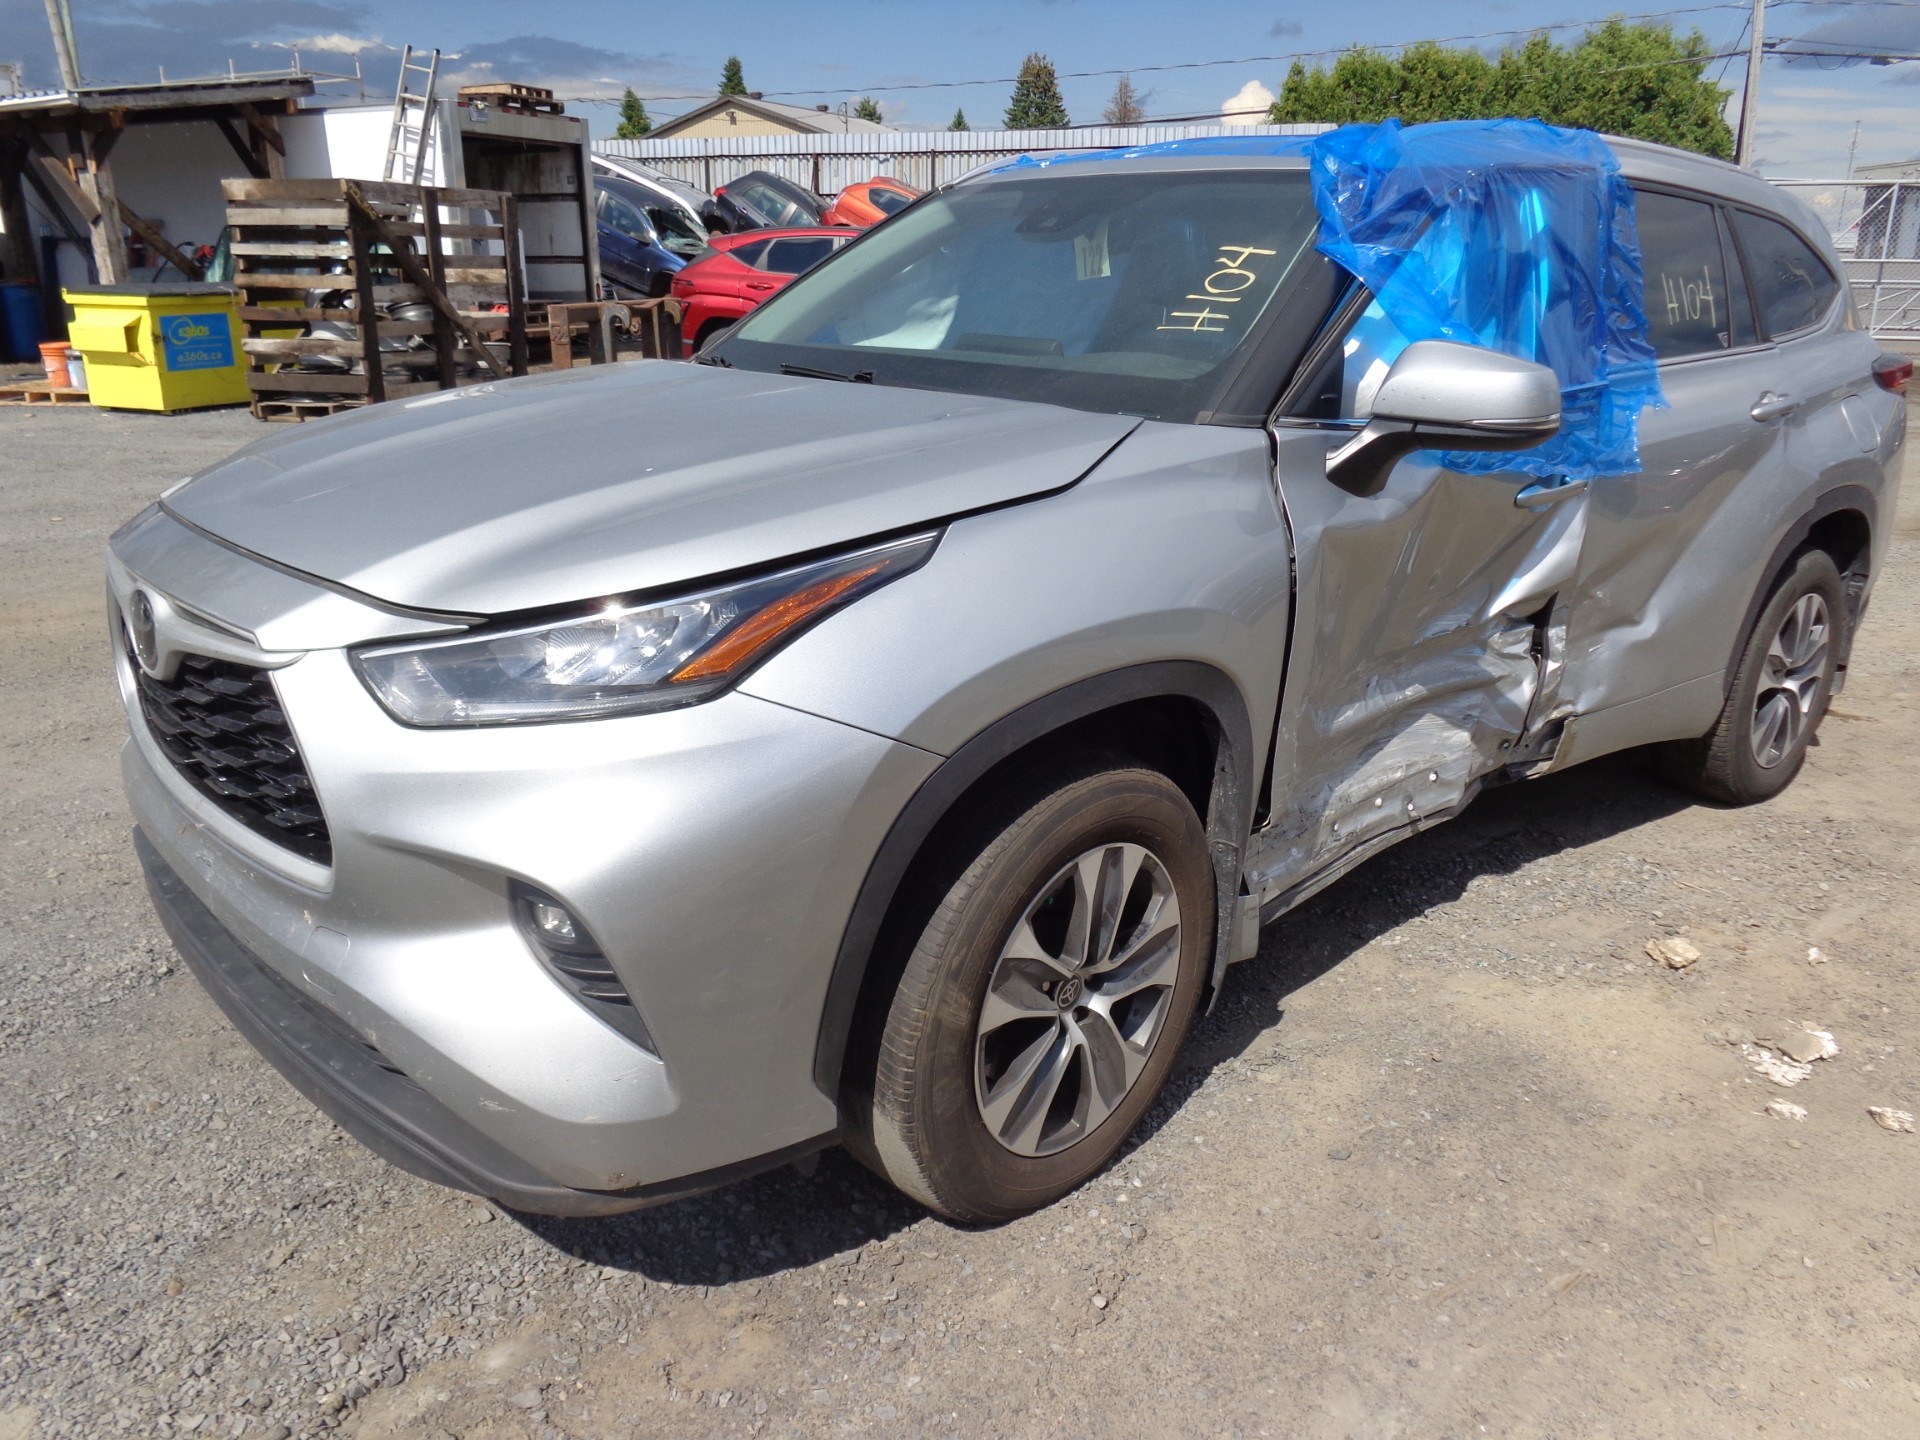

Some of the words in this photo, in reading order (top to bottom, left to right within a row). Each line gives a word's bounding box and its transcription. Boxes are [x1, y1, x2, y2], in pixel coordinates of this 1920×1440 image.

[1156, 245, 1277, 332] H104
[1661, 265, 1716, 328] H104
[177, 350, 222, 362] e360s.ca
